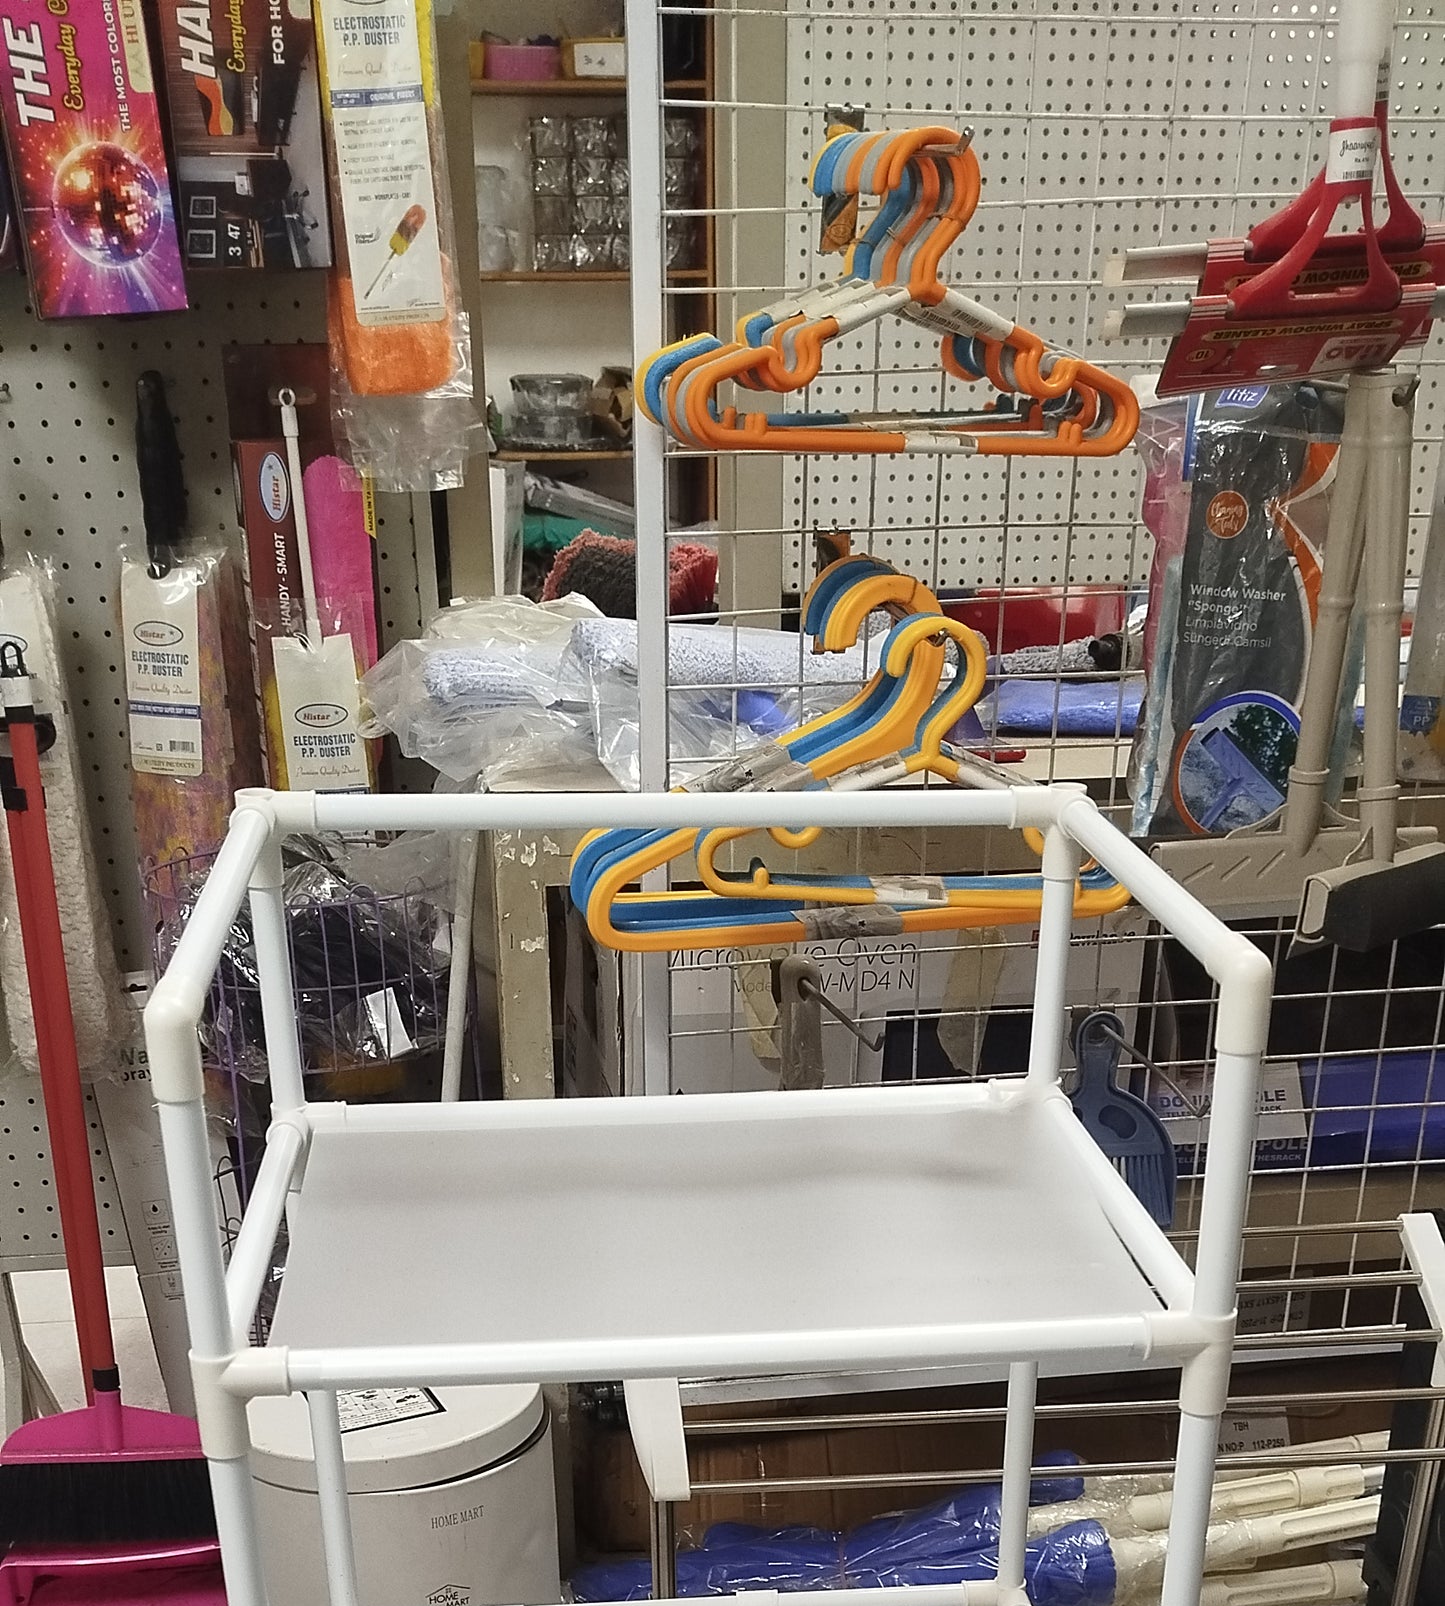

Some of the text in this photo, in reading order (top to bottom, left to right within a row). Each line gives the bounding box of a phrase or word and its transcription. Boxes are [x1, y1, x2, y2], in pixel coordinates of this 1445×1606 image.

[333, 15, 406, 31] ELECTROSTATIC
[271, 25, 286, 65] FOR
[343, 31, 400, 46] P.P. DUSTER
[2, 17, 56, 127] THE
[56, 22, 85, 111] Everyday
[102, 0, 132, 133] THE MOST COLOR
[1212, 319, 1393, 341] SPRAY WINDOW CLEANER
[272, 475, 282, 511] Histar
[274, 532, 288, 574] SMART
[1190, 584, 1287, 601] Window Washer
[278, 583, 292, 626] HANDY
[140, 629, 166, 639] Histar
[131, 650, 190, 666] ELECTROSTATIC
[137, 664, 183, 677] P.P. DUSTER
[302, 712, 331, 721] Histar
[293, 733, 356, 746] ELECTROSTATIC
[301, 745, 351, 758] P.P. DUSTER
[836, 937, 917, 967] Oven
[431, 1504, 485, 1529] HOME MART
[429, 1591, 459, 1605] HOME
